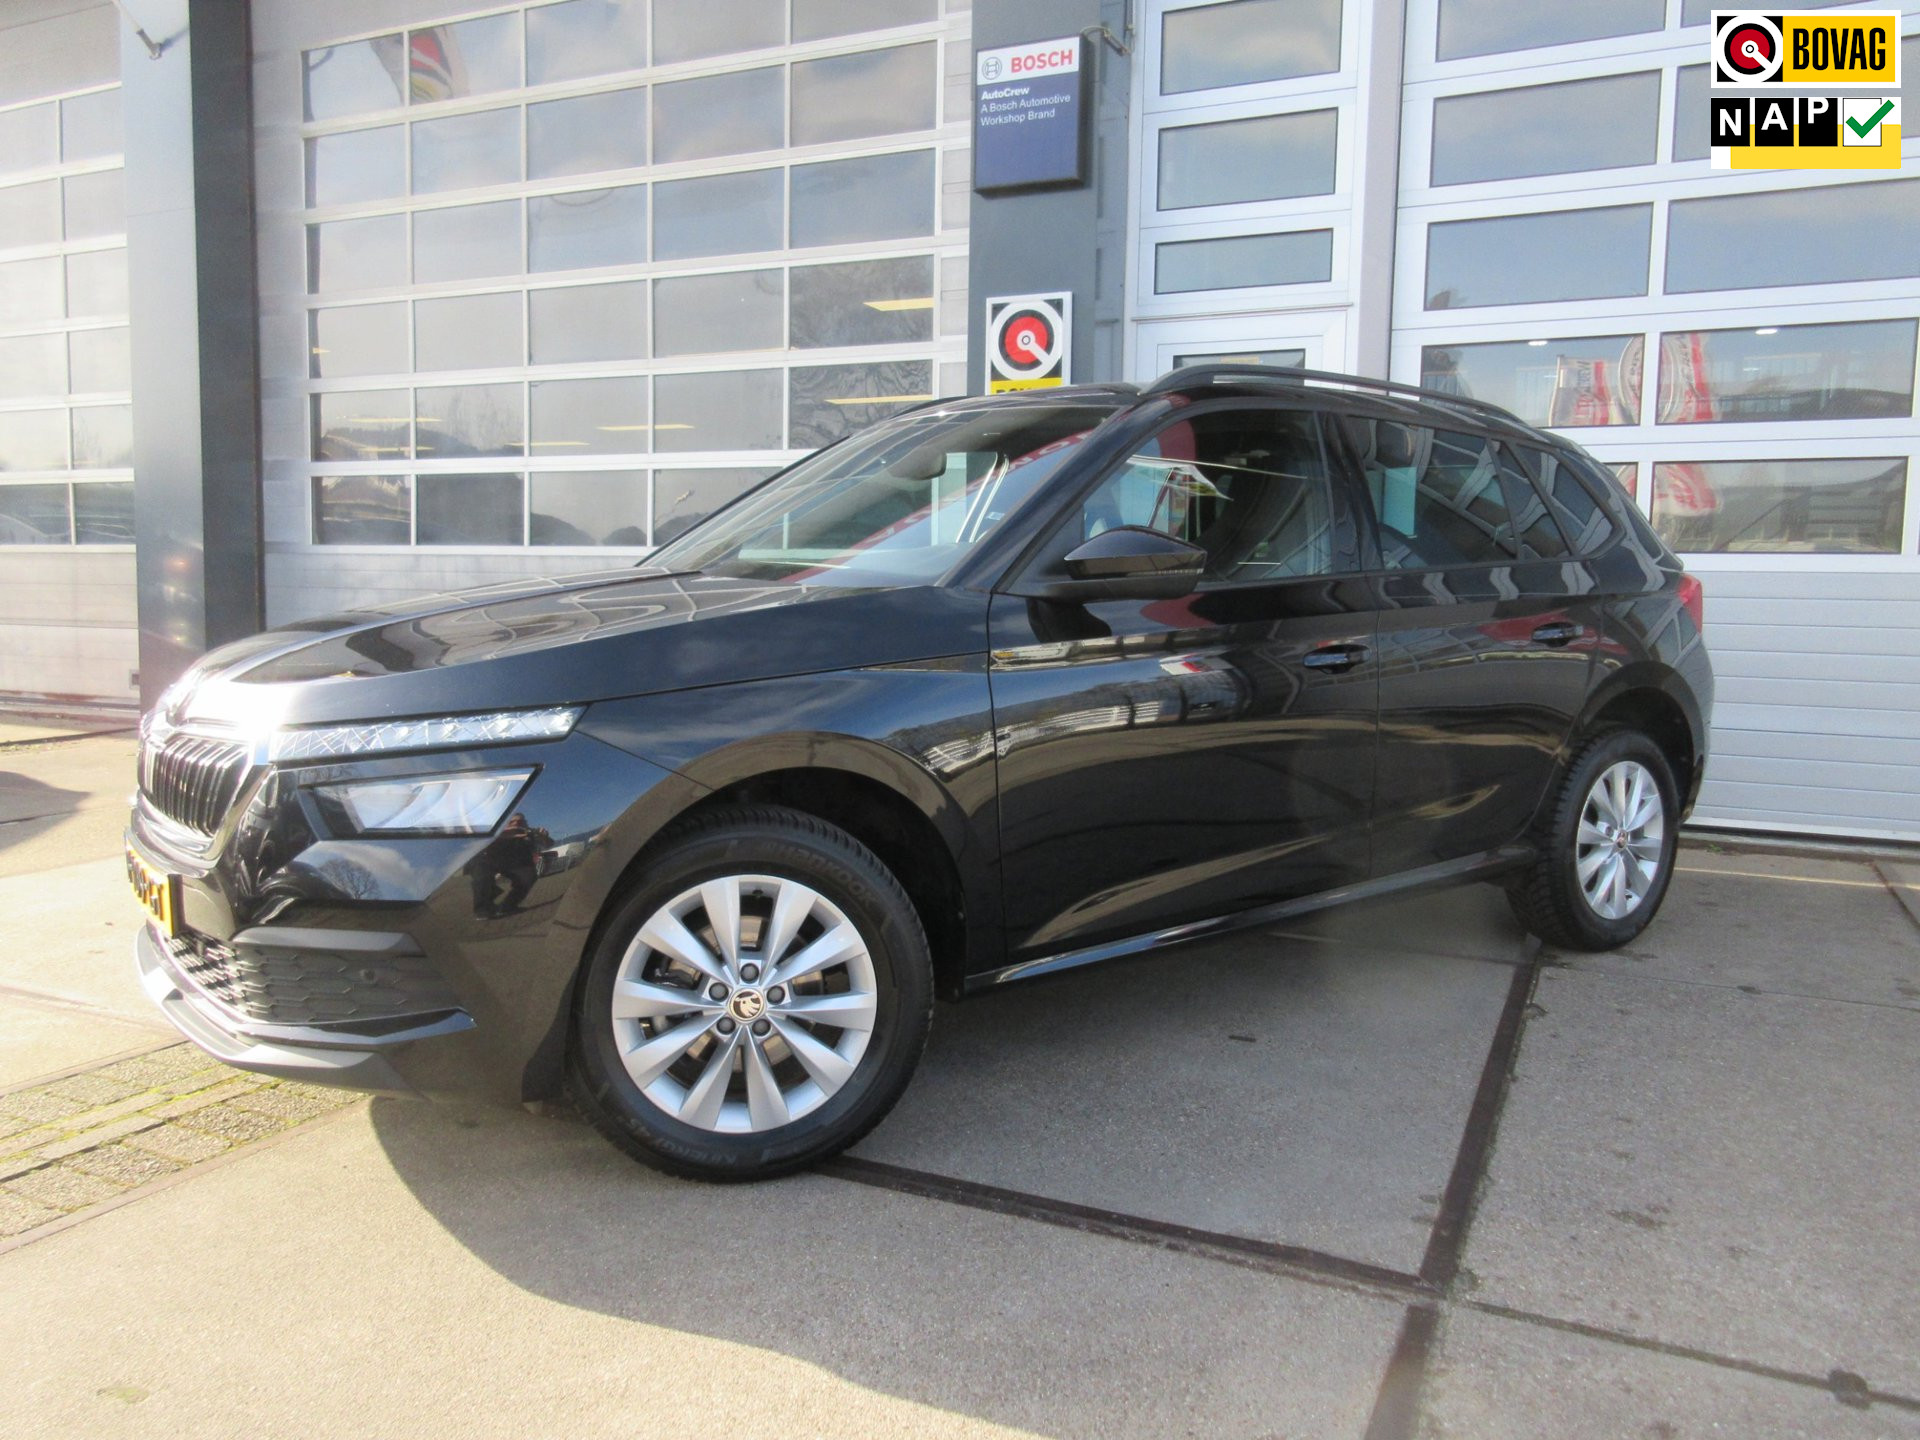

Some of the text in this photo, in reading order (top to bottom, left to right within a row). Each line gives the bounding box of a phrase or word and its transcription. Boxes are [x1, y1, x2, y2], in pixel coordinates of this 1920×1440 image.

[1011, 49, 1073, 73] BOSCH
[981, 87, 1030, 100] AutoCrew
[980, 94, 1071, 114] A Bosch Automotive
[981, 109, 1055, 126] Workshop Brand
